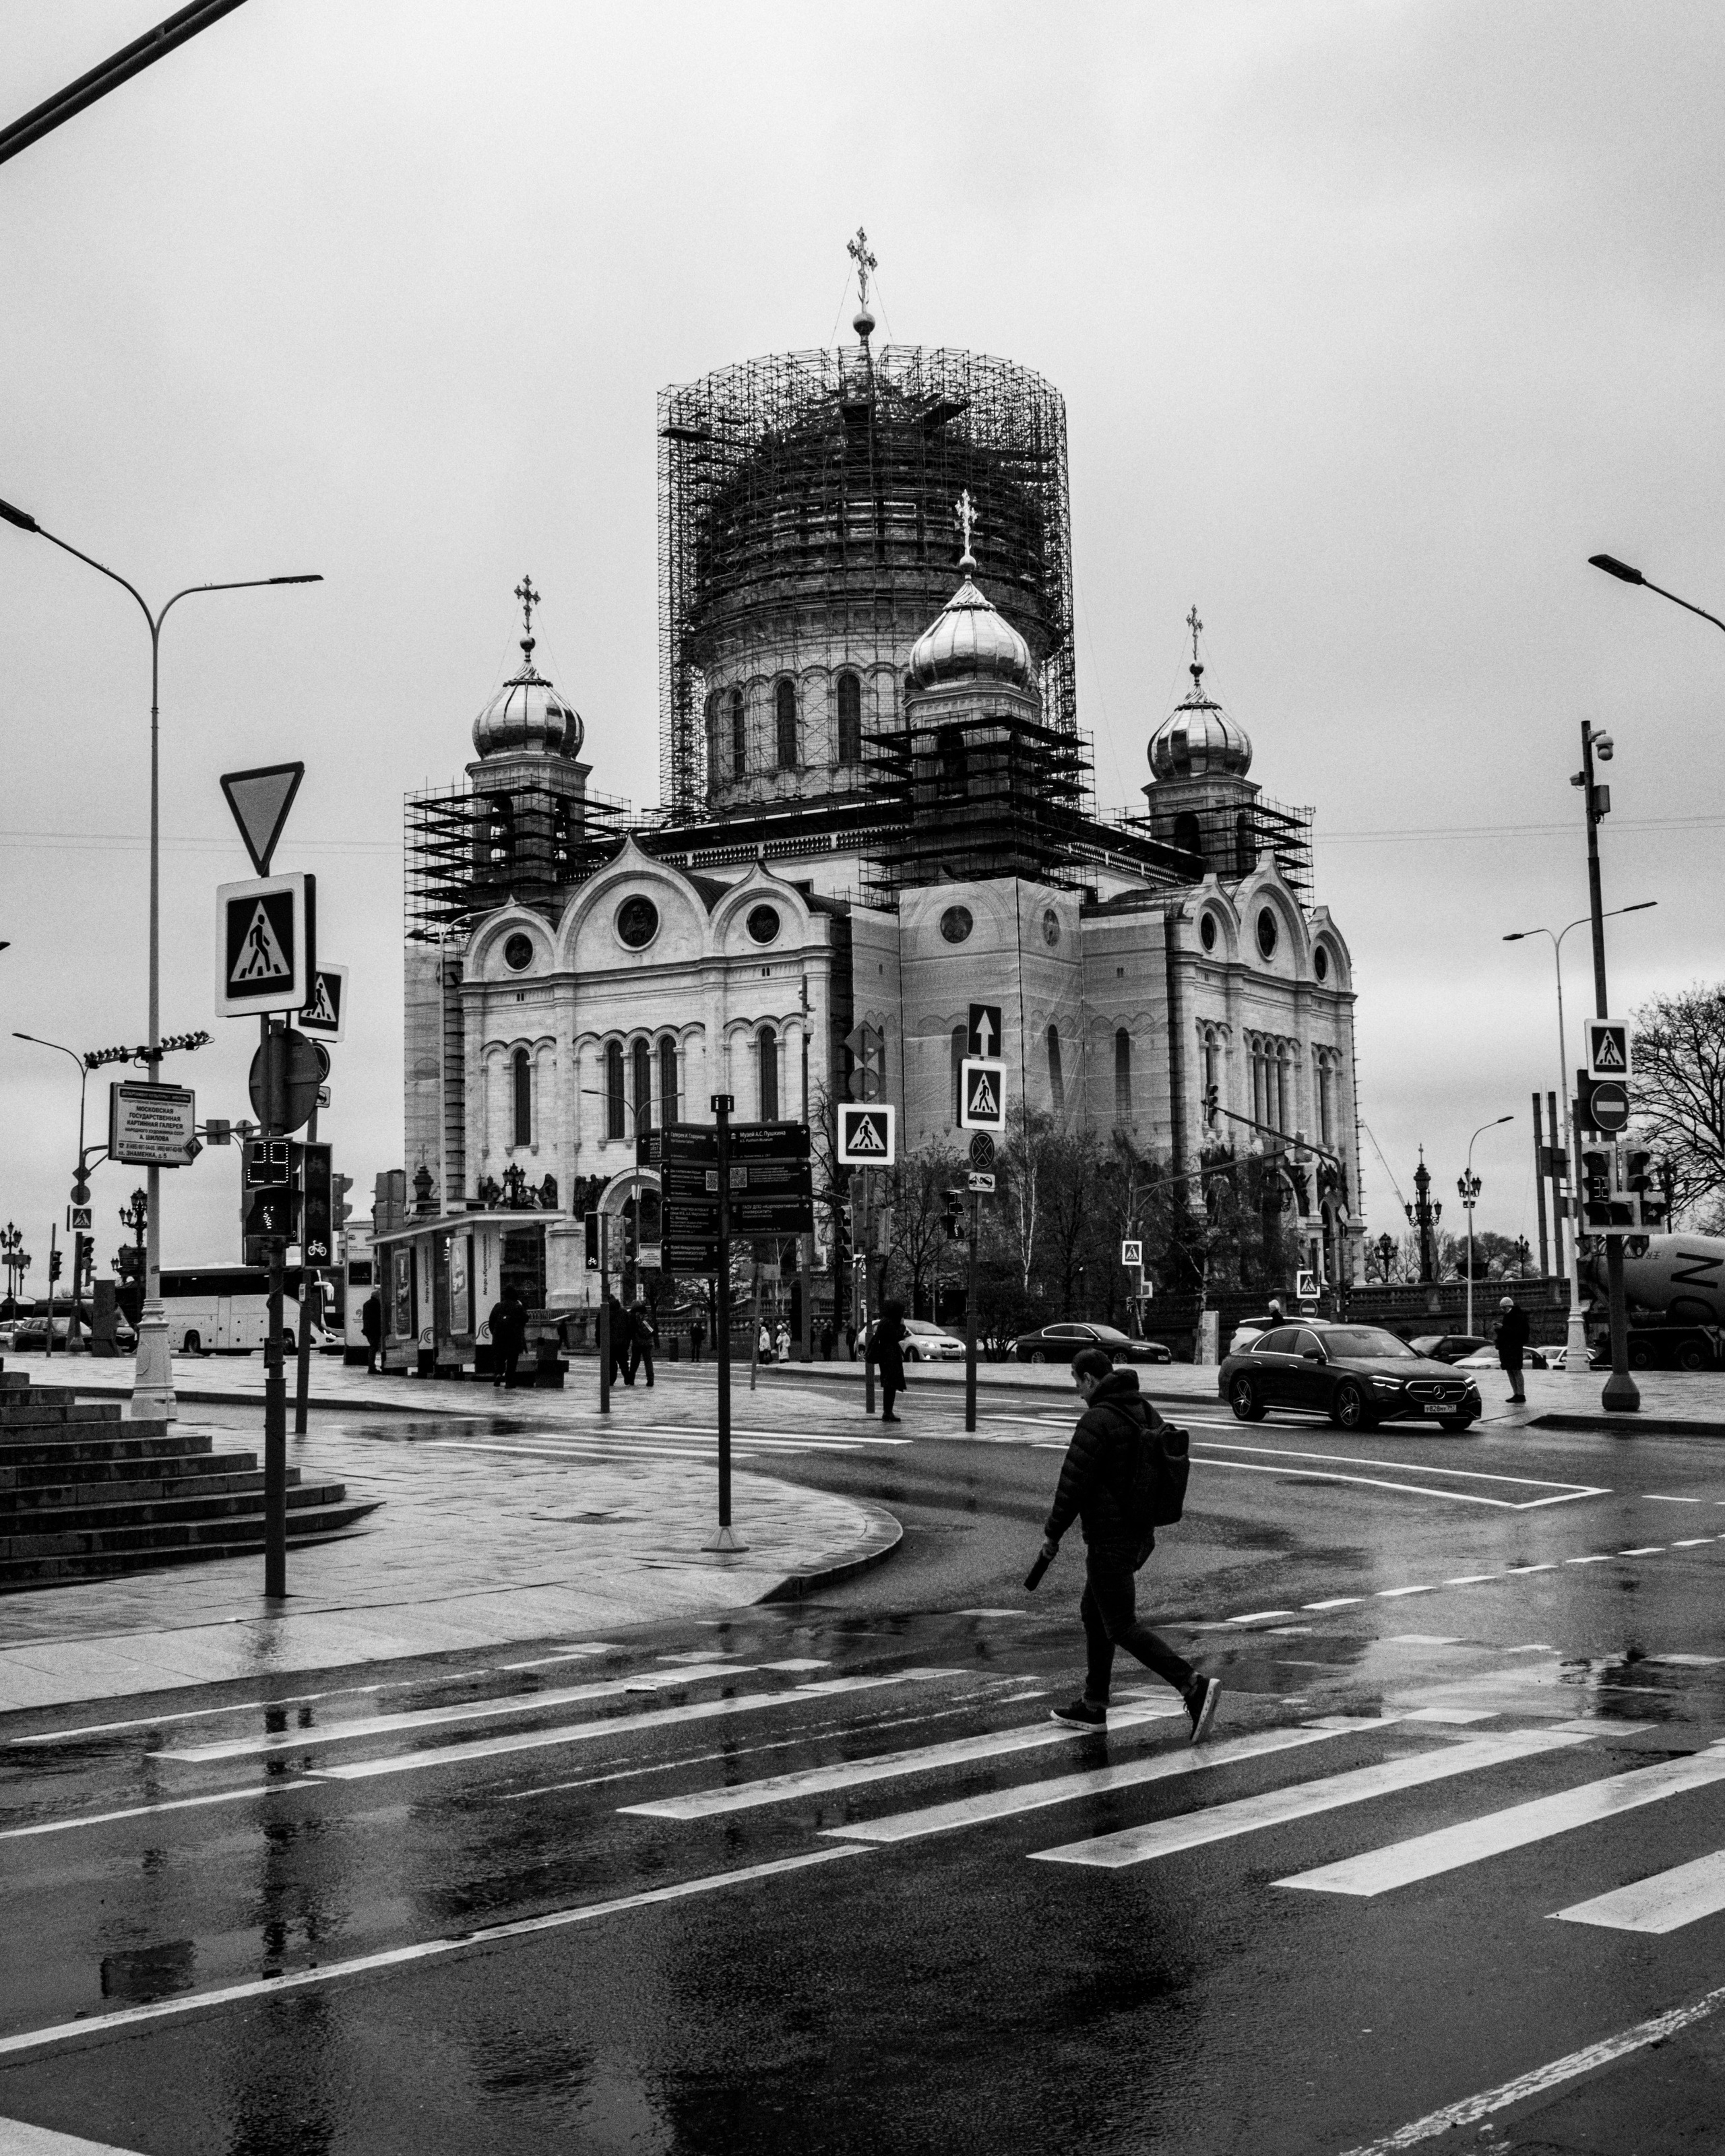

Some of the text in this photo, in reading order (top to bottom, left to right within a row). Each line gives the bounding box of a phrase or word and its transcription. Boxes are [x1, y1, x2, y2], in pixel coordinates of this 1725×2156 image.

[136, 1106, 174, 1114] МОСКОВСКАЯ
[129, 1112, 181, 1122] ГОСУДАРСТВЕННАЯ
[127, 1119, 158, 1127] КАРТИННАЯ
[247, 1141, 289, 1183] 29
